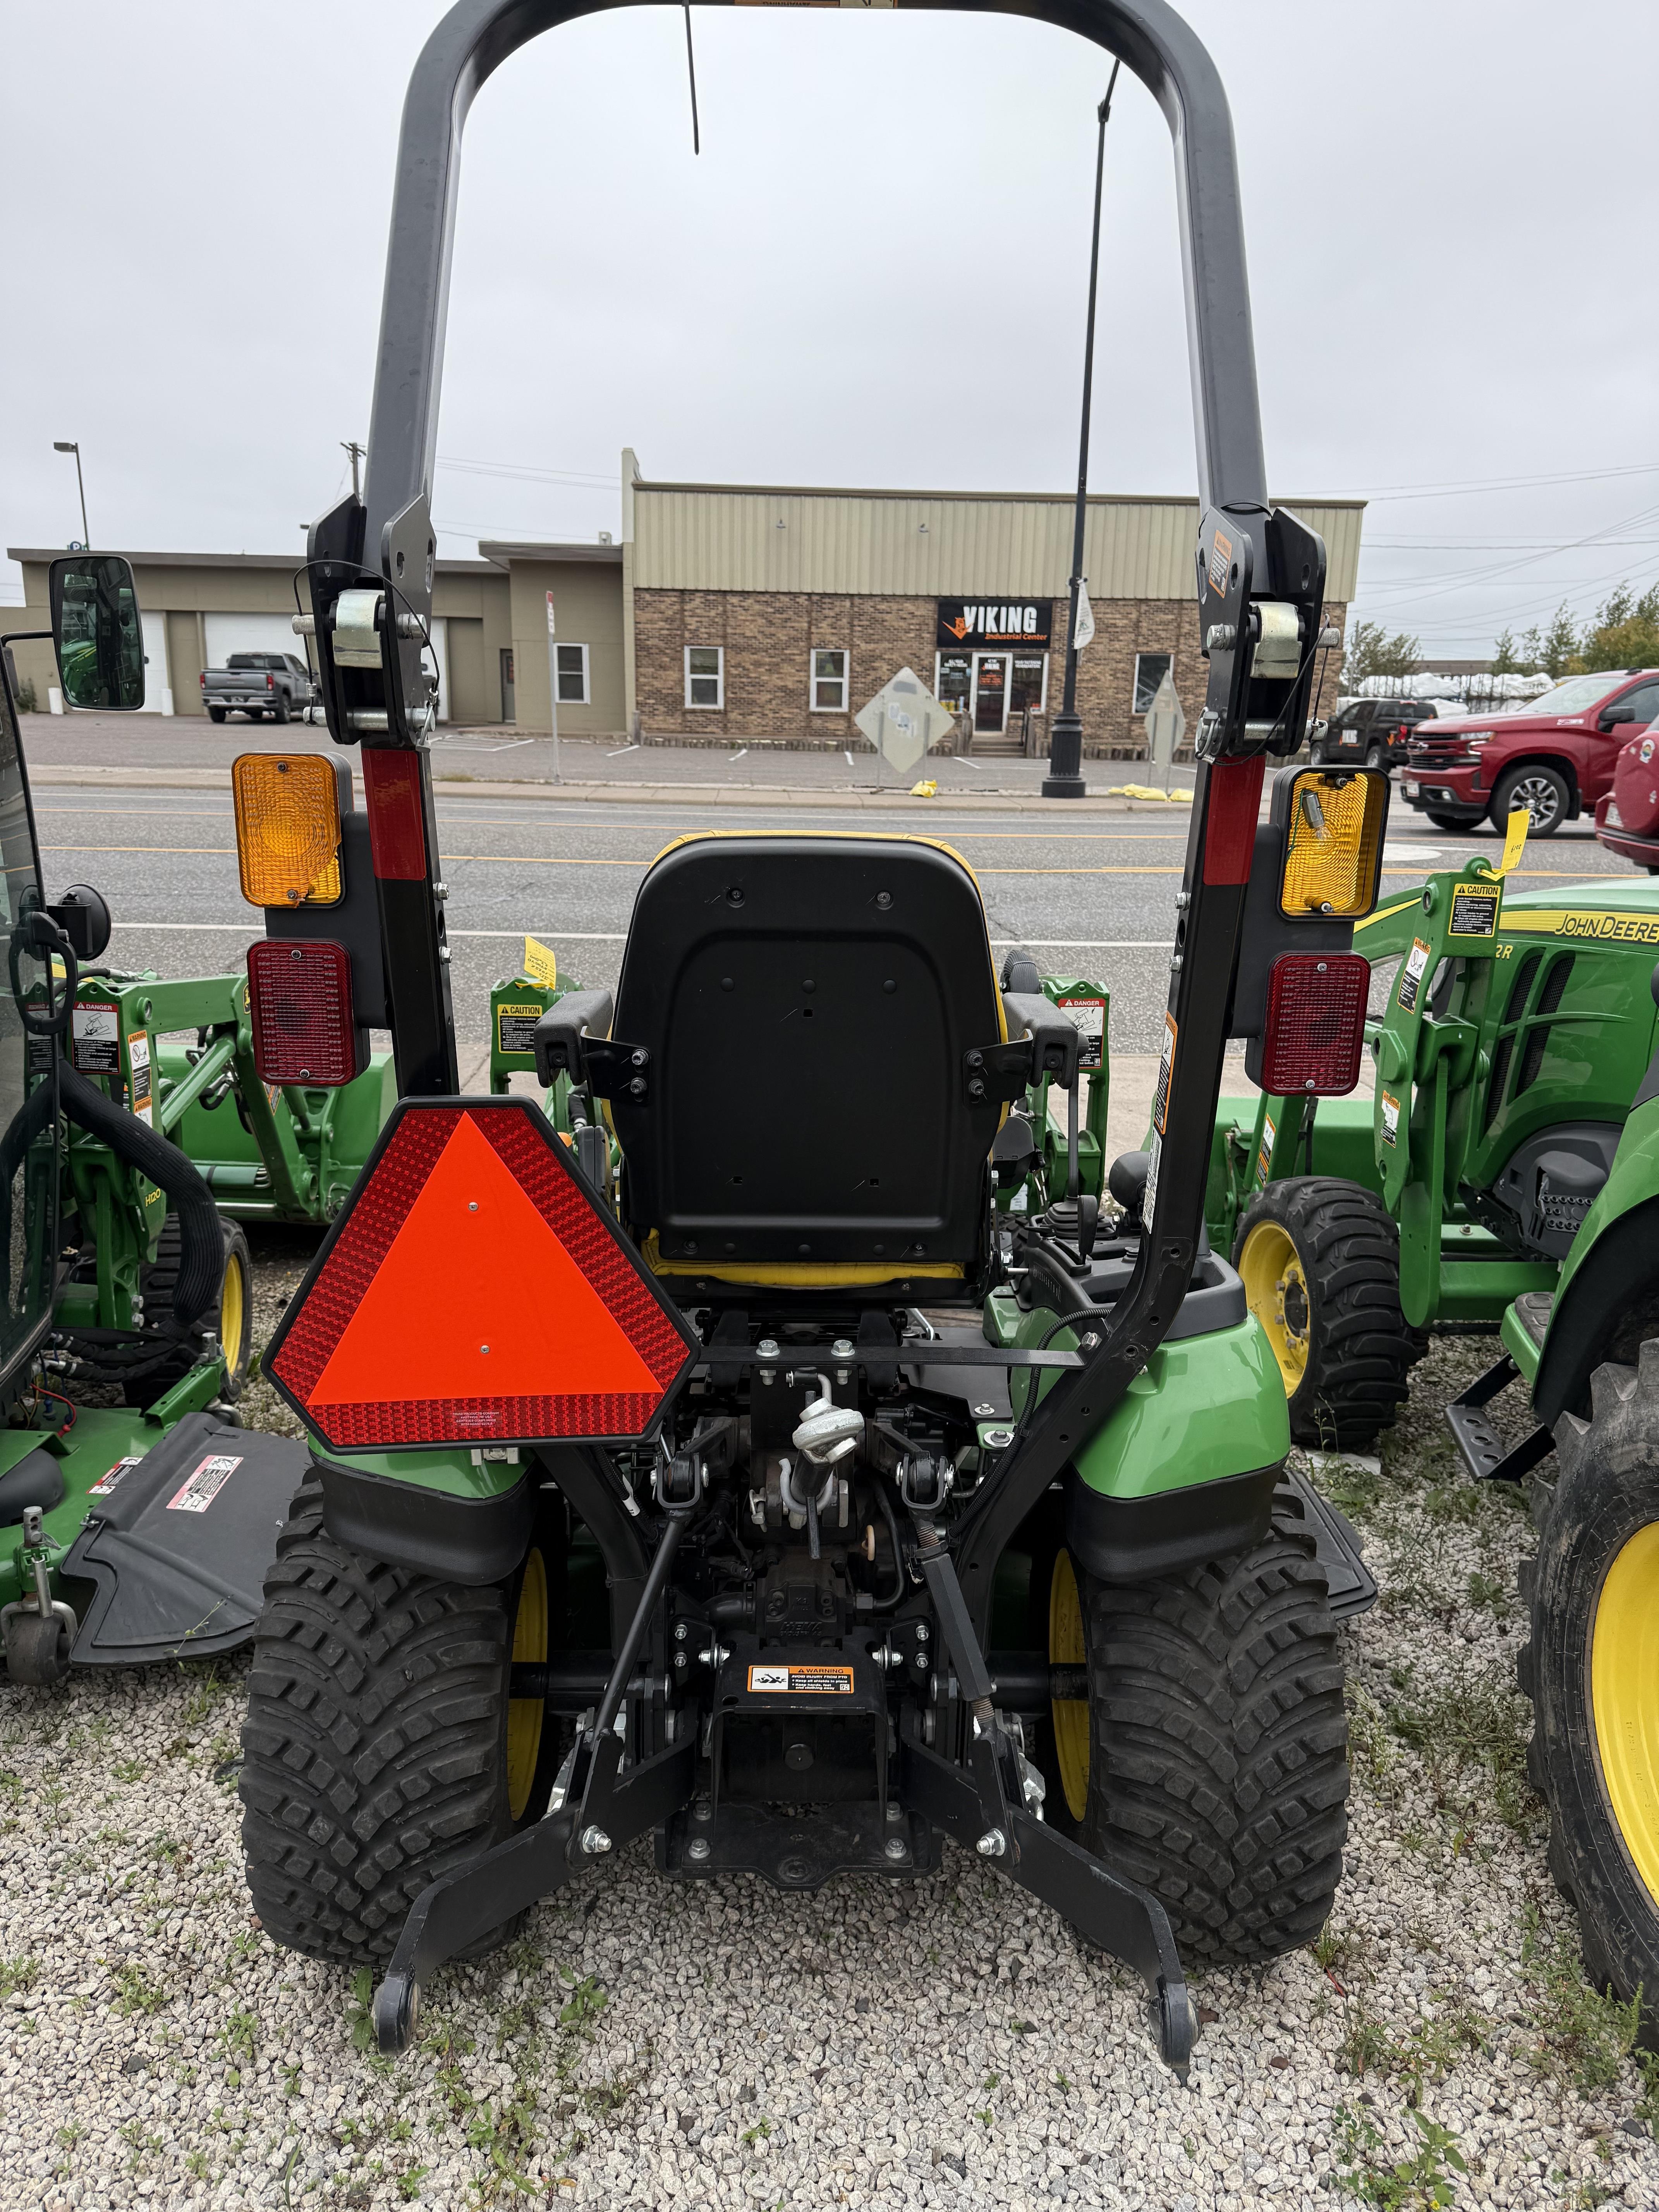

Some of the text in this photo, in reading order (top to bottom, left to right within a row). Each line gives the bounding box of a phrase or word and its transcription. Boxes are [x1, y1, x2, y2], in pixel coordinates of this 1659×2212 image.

[963, 606, 1037, 633] VIKING
[1468, 886, 1498, 895] CAUTION
[1556, 914, 1659, 940] JOHN DEERE
[132, 1031, 146, 1041] WARNING
[145, 1188, 161, 1207] H120
